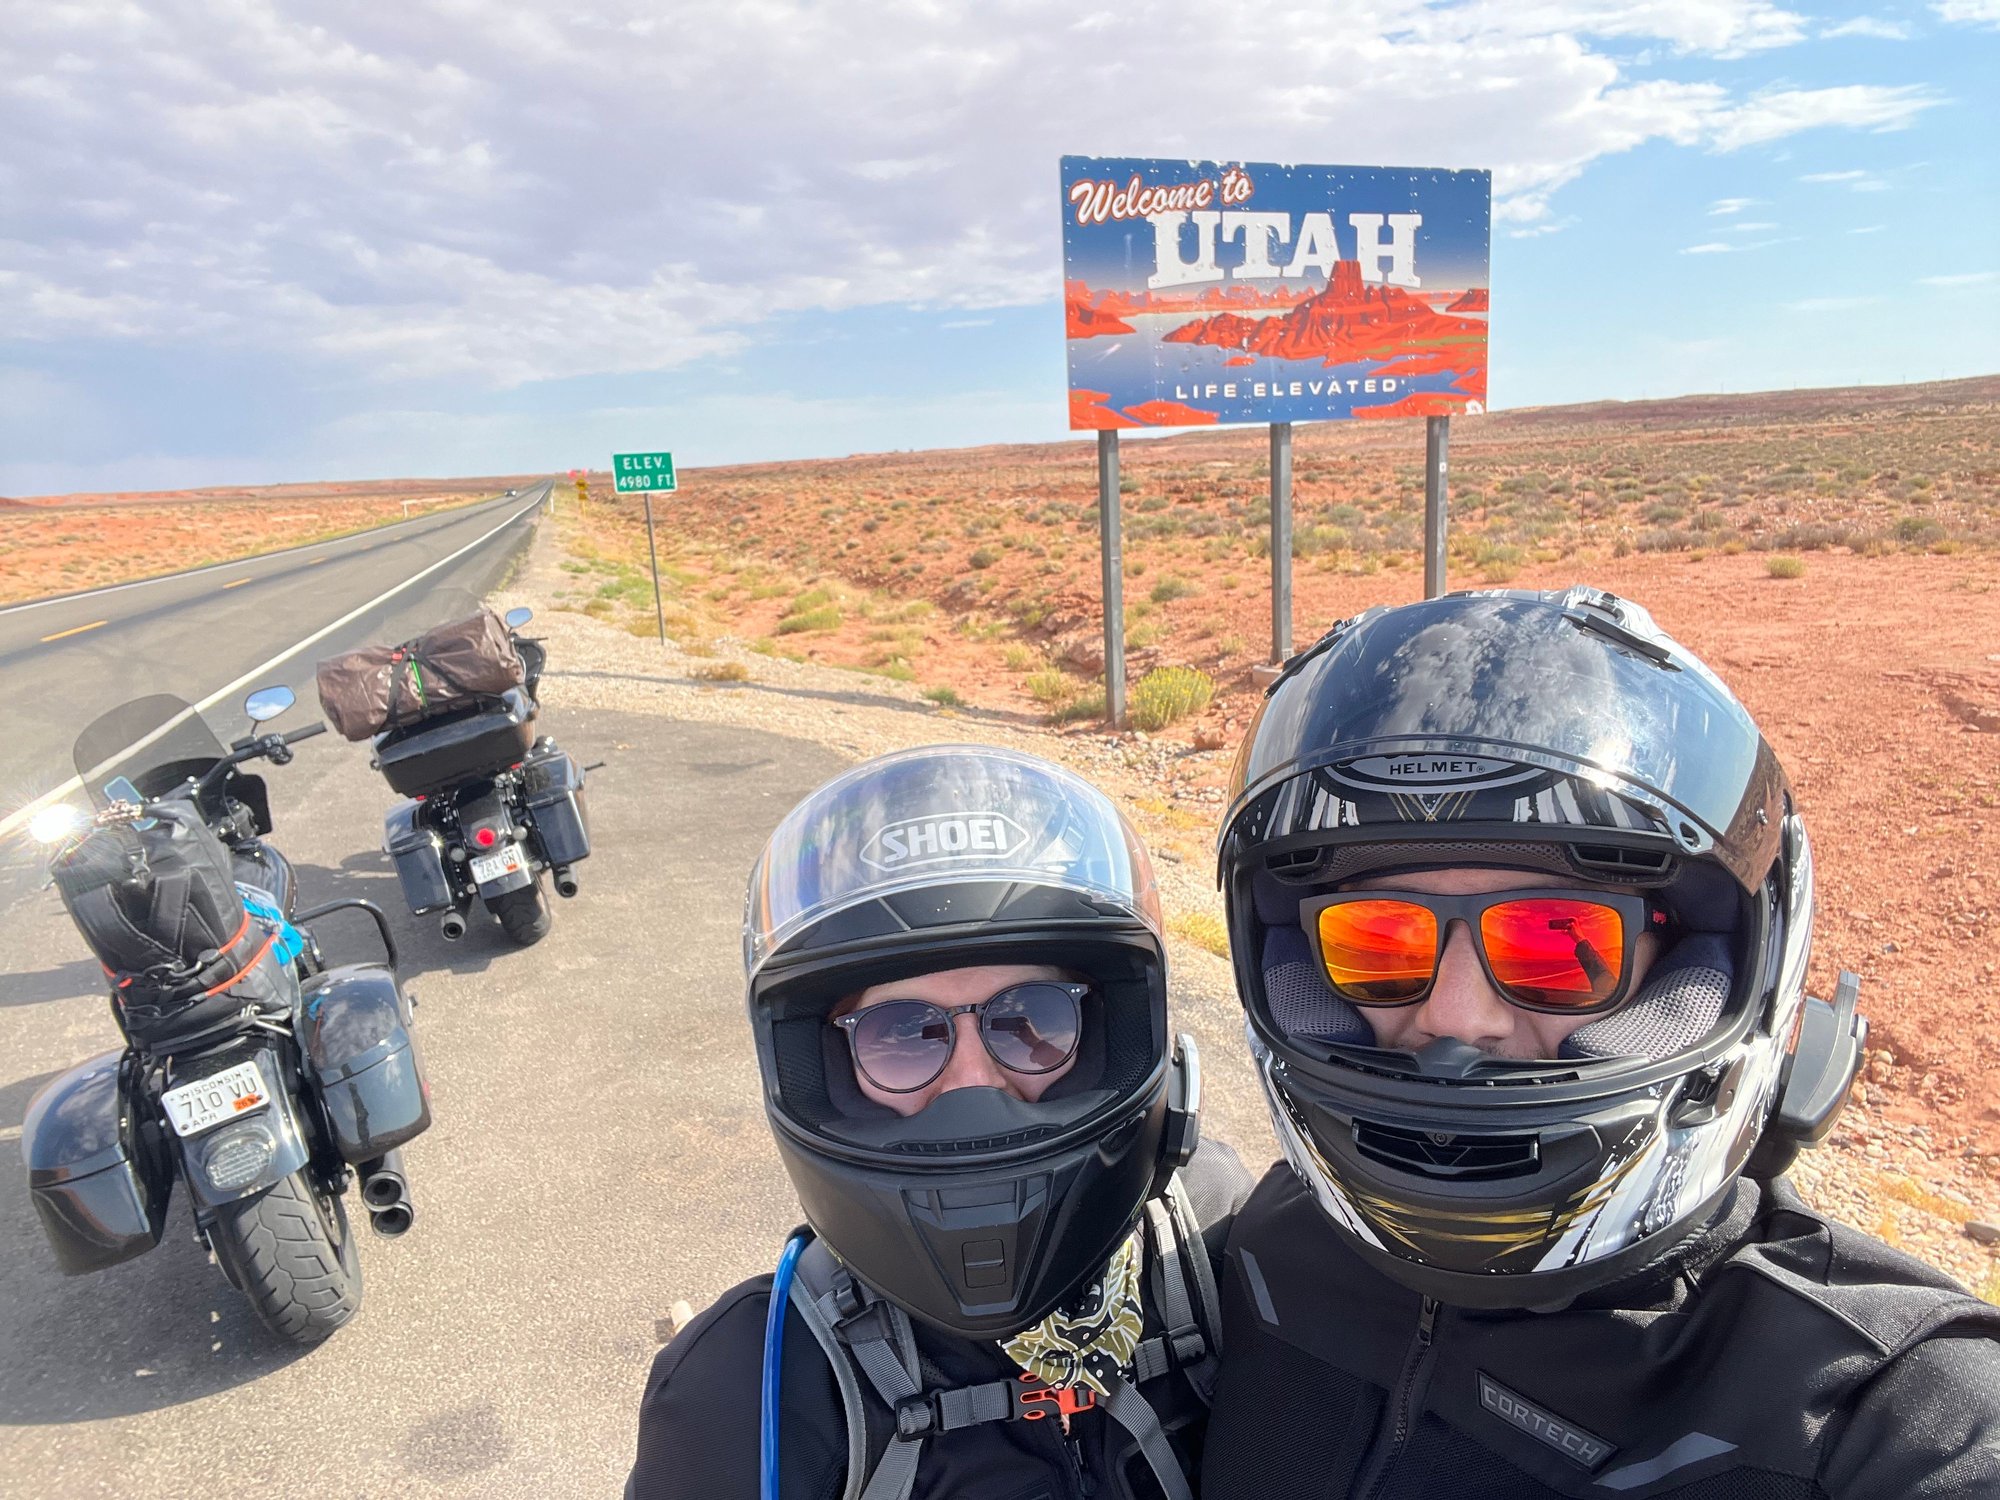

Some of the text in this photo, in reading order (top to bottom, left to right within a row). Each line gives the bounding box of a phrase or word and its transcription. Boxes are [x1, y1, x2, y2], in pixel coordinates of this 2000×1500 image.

[1071, 167, 1253, 225] Welcome to
[1146, 211, 1423, 288] UTAH
[1175, 378, 1398, 400] LIFE ELEVATED
[619, 475, 651, 489] 4980
[881, 819, 1008, 863] SHOEI
[180, 1072, 242, 1099] WISCONSIN
[180, 1077, 257, 1119] 710 VU
[193, 1112, 218, 1127] APR
[1483, 1384, 1600, 1460] CORTECH
